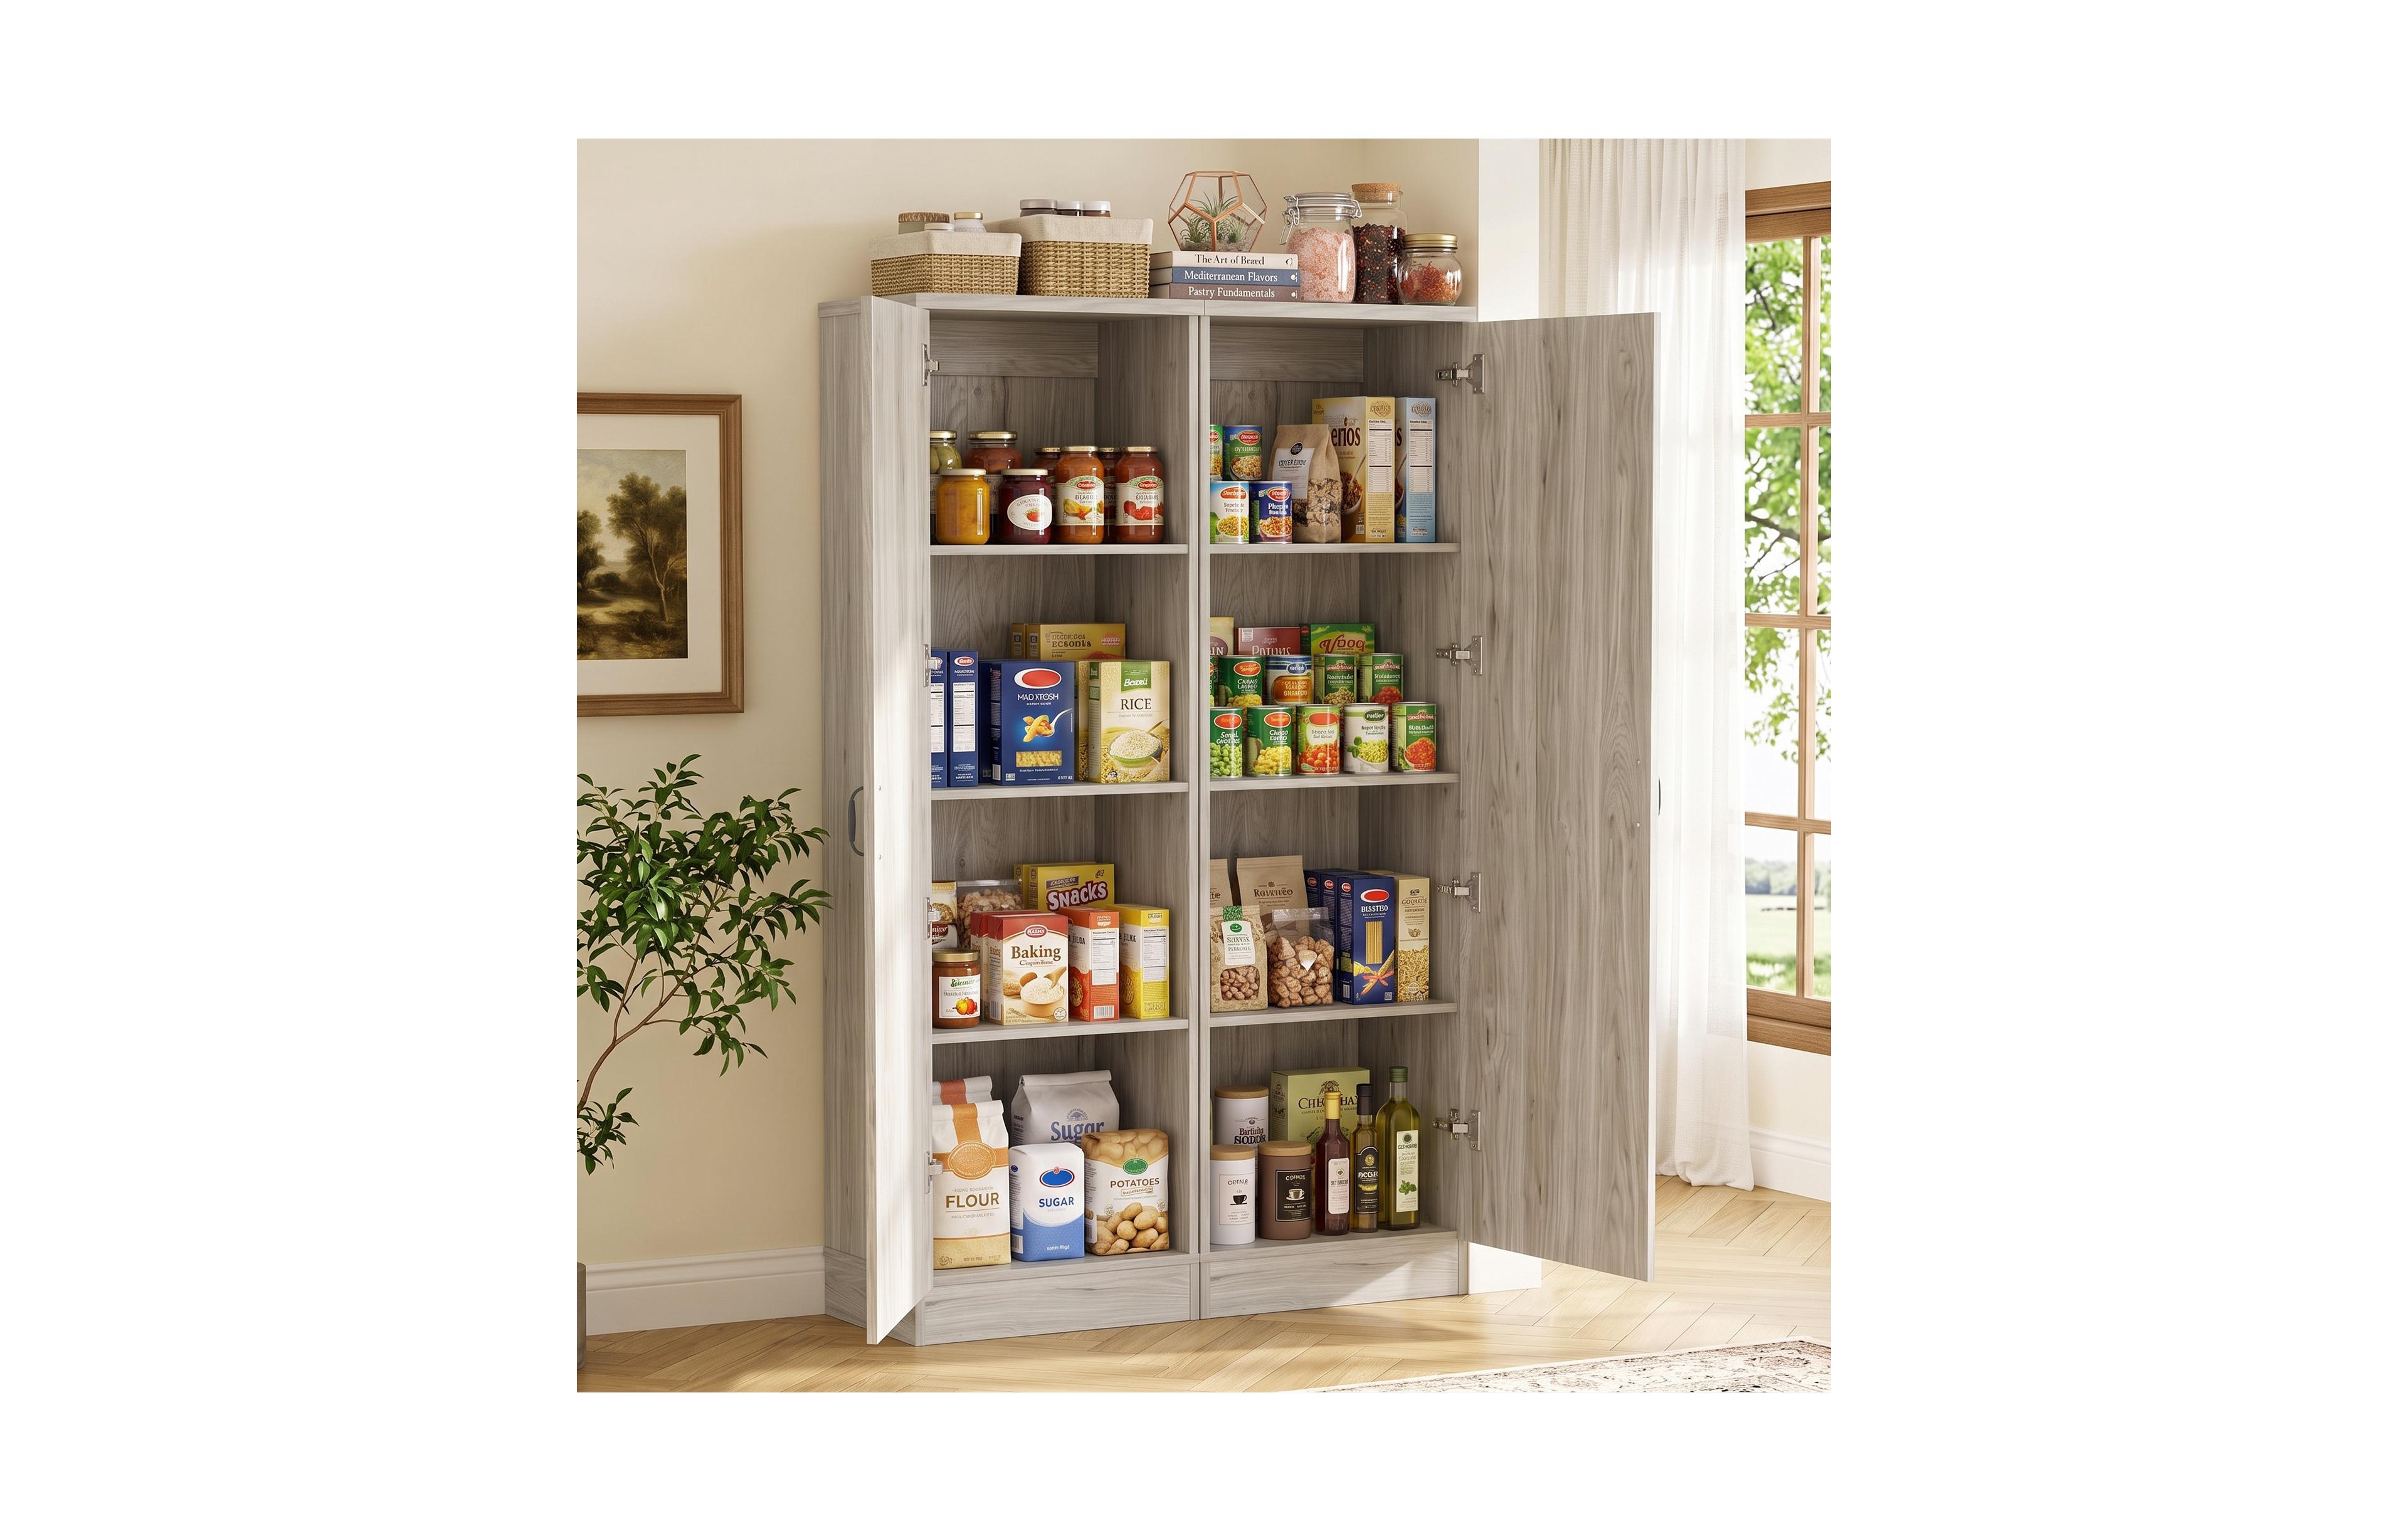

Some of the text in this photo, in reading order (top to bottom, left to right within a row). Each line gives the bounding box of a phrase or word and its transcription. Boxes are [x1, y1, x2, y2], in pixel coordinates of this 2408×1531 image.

[1195, 254, 1212, 264] The
[1213, 255, 1227, 265] Art
[1230, 255, 1238, 265] of
[1185, 270, 1278, 282] Mediterranean Flavors
[1188, 286, 1275, 298] Pastry Fundamentals
[1120, 698, 1152, 710] RICE
[1011, 945, 1061, 961] Baking
[1110, 1177, 1159, 1189] POTATOES
[945, 1192, 1000, 1209] FLOUR
[1038, 1196, 1074, 1208] SUGAR
